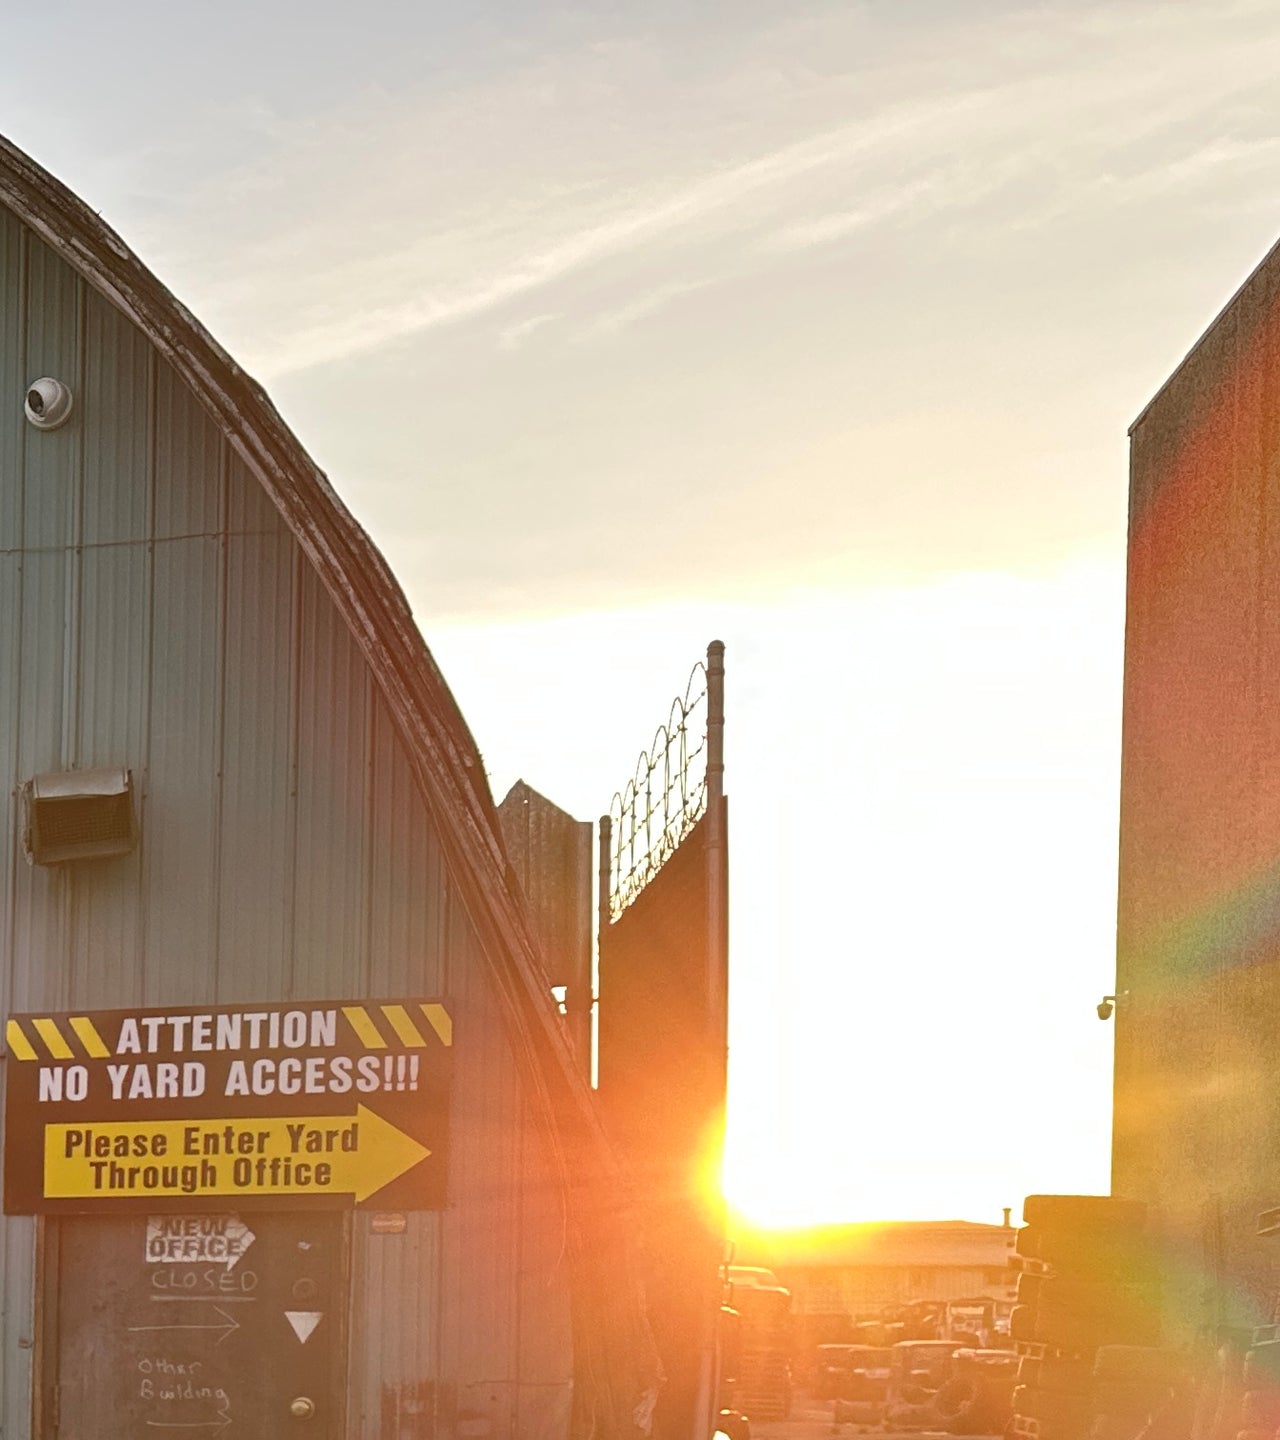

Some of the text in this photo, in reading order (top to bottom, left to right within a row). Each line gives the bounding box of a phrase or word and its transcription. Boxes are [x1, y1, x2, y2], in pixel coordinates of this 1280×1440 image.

[116, 1009, 337, 1055] ATTENTION
[39, 1054, 420, 1102] NO YARD ACCESS!!!
[64, 1122, 360, 1159] Please Enter Yard
[89, 1157, 332, 1194] Through Office
[160, 1218, 225, 1237] NEW
[149, 1235, 245, 1258] OFFICE
[151, 1268, 259, 1292] CLOSED
[138, 1358, 203, 1376] Other
[140, 1379, 231, 1411] Building
